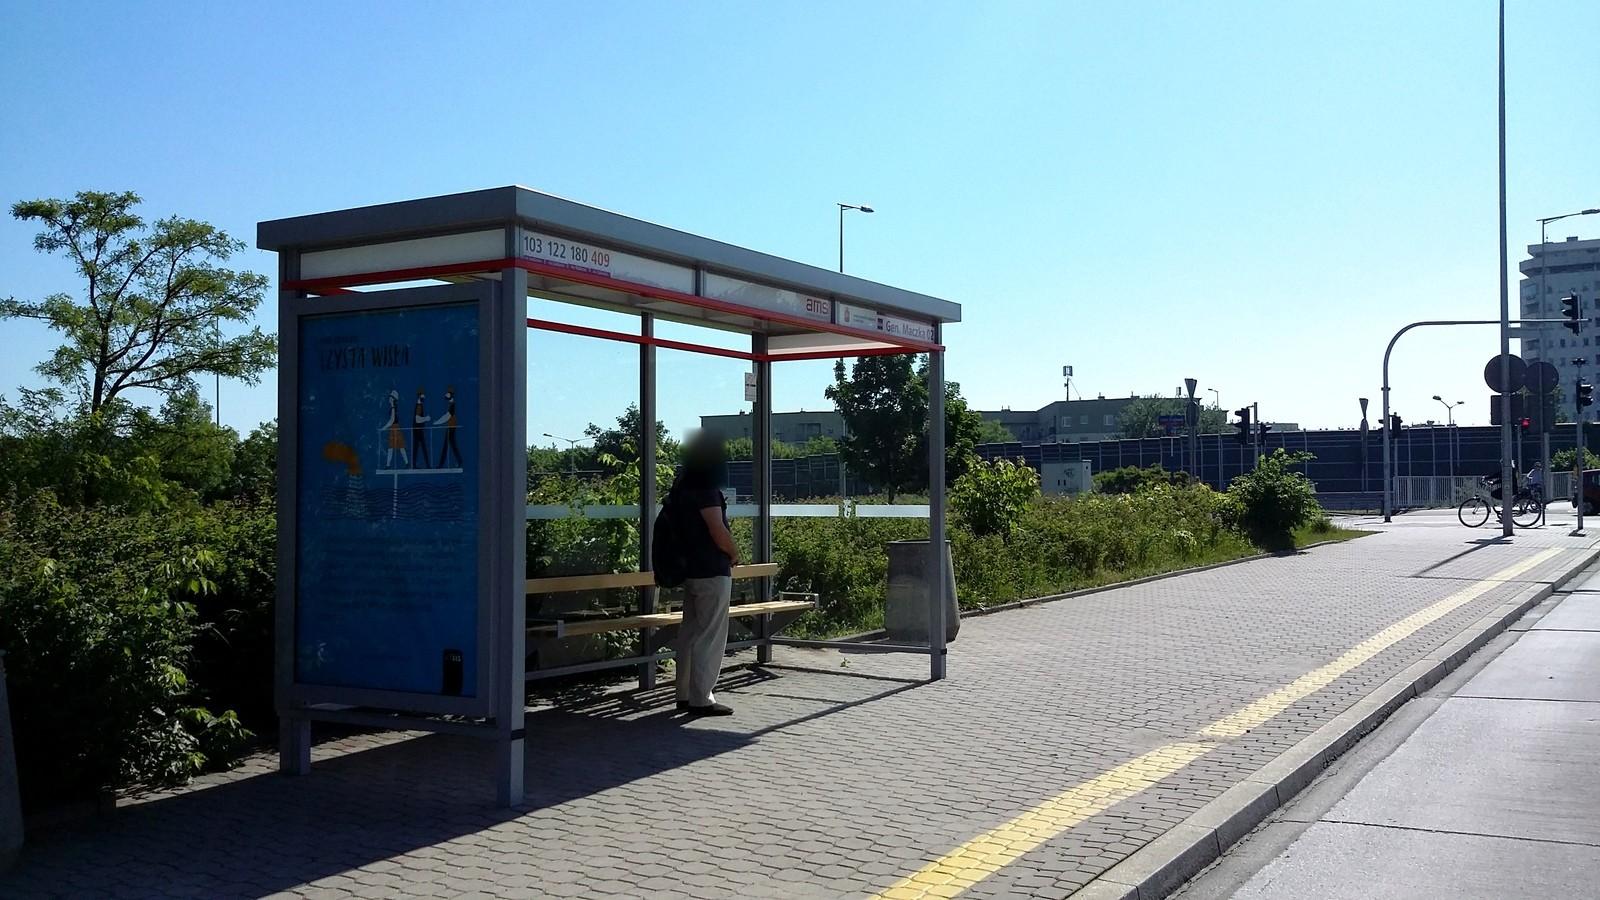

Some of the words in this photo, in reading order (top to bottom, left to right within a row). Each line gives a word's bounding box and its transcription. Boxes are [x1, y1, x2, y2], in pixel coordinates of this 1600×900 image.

[524, 236, 542, 254] 103
[547, 241, 566, 259] 122
[570, 246, 588, 263] 180
[591, 251, 610, 268] 409
[806, 298, 829, 315] ams
[885, 320, 899, 333] Gen.
